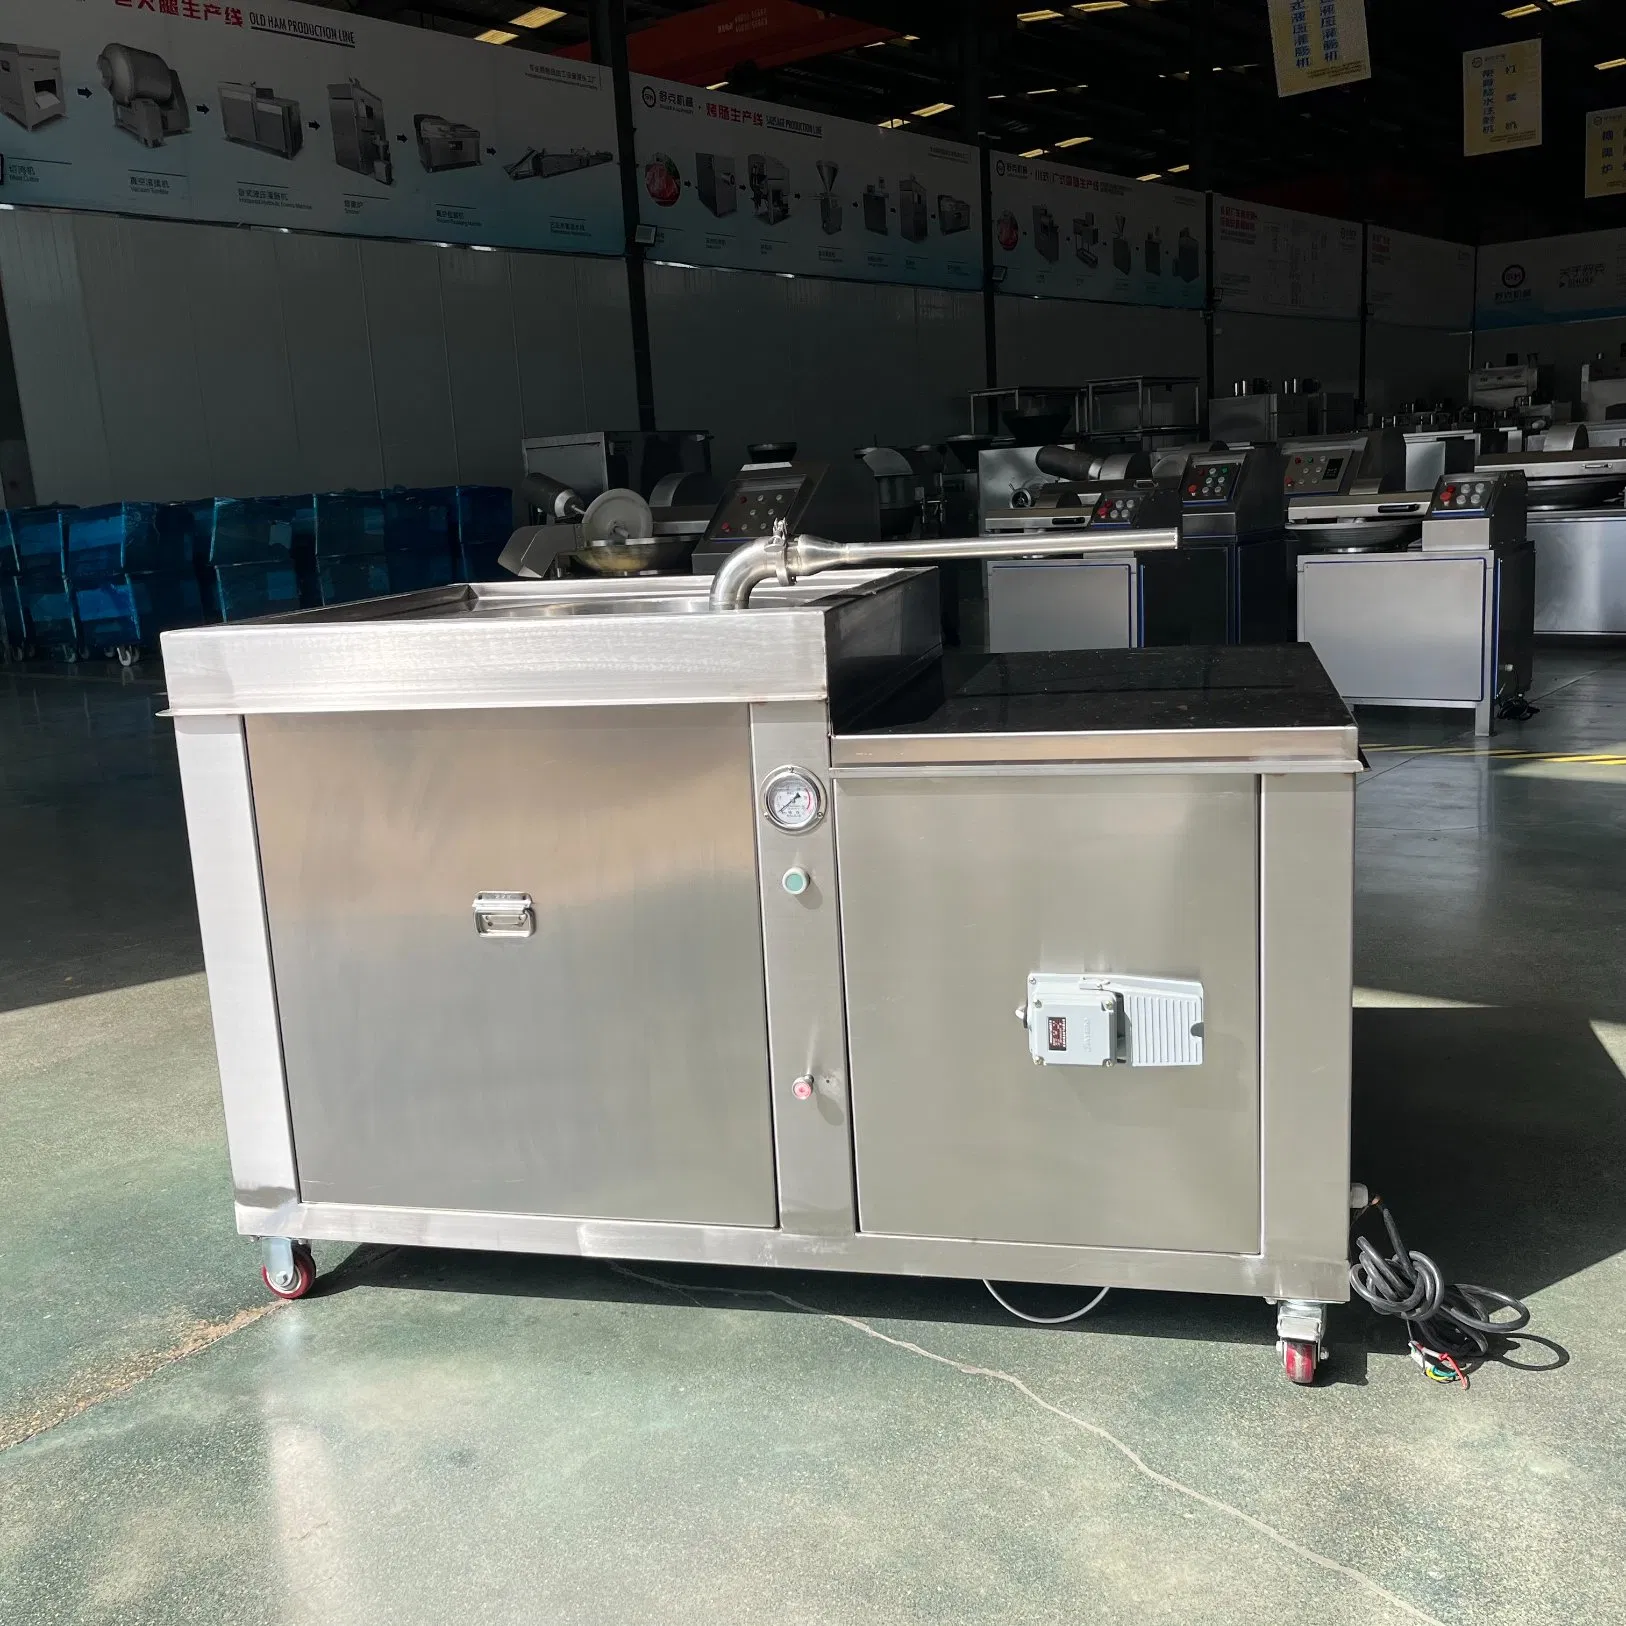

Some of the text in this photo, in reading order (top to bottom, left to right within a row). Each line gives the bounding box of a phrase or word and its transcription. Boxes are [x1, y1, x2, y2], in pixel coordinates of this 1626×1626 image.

[249, 11, 356, 44] OLD HAM PRODUCTION LINE
[705, 102, 764, 127] 烤肠生产线
[785, 119, 812, 133] PRODUCTION
